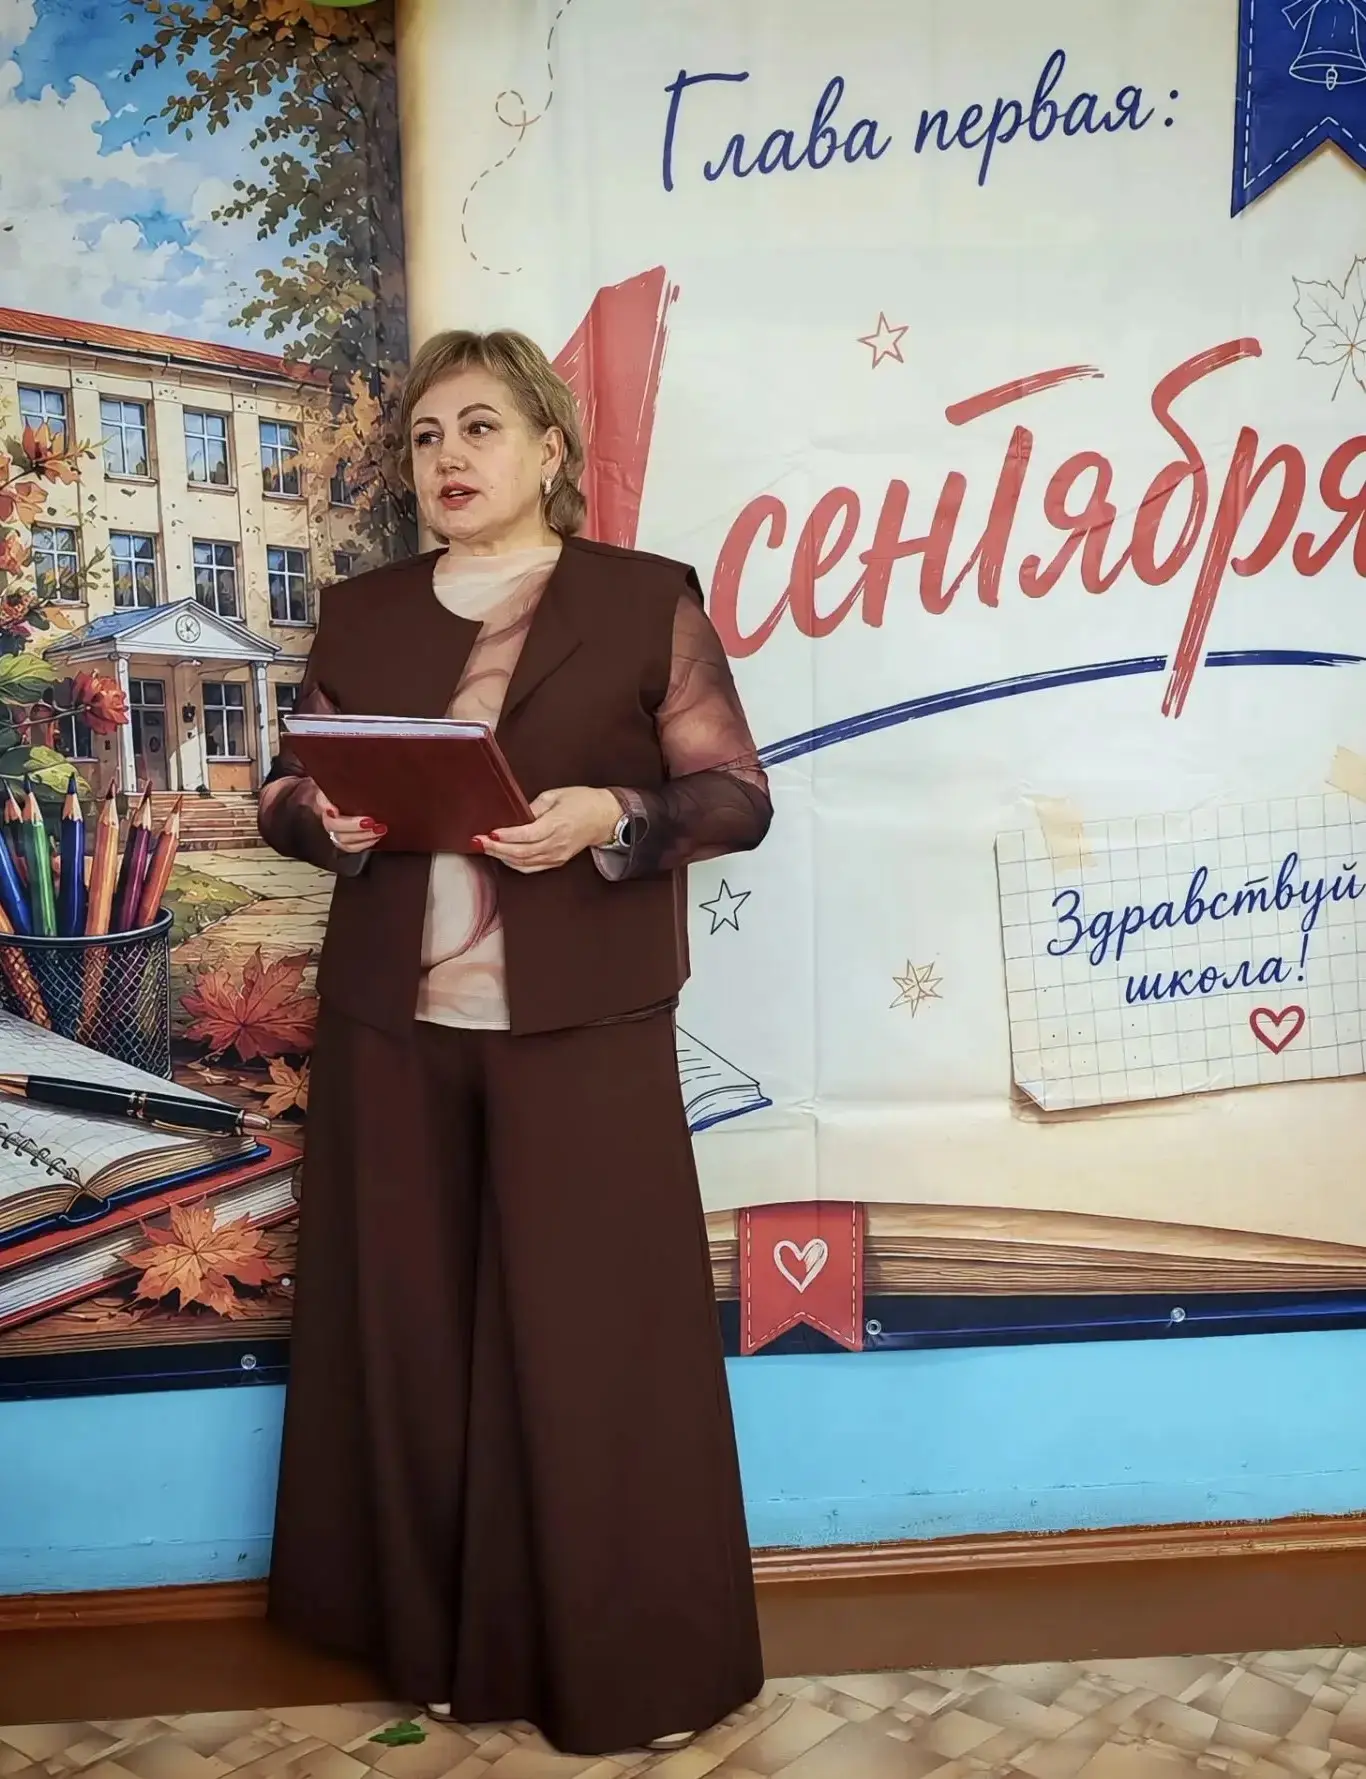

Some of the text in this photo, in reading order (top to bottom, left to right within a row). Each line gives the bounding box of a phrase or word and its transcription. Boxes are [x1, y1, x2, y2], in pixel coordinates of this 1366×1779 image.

[663, 49, 1180, 192] Глава первая:
[708, 336, 1366, 719] сентября
[1046, 852, 1366, 966] Здравствуй
[1125, 932, 1309, 1004] школа!
